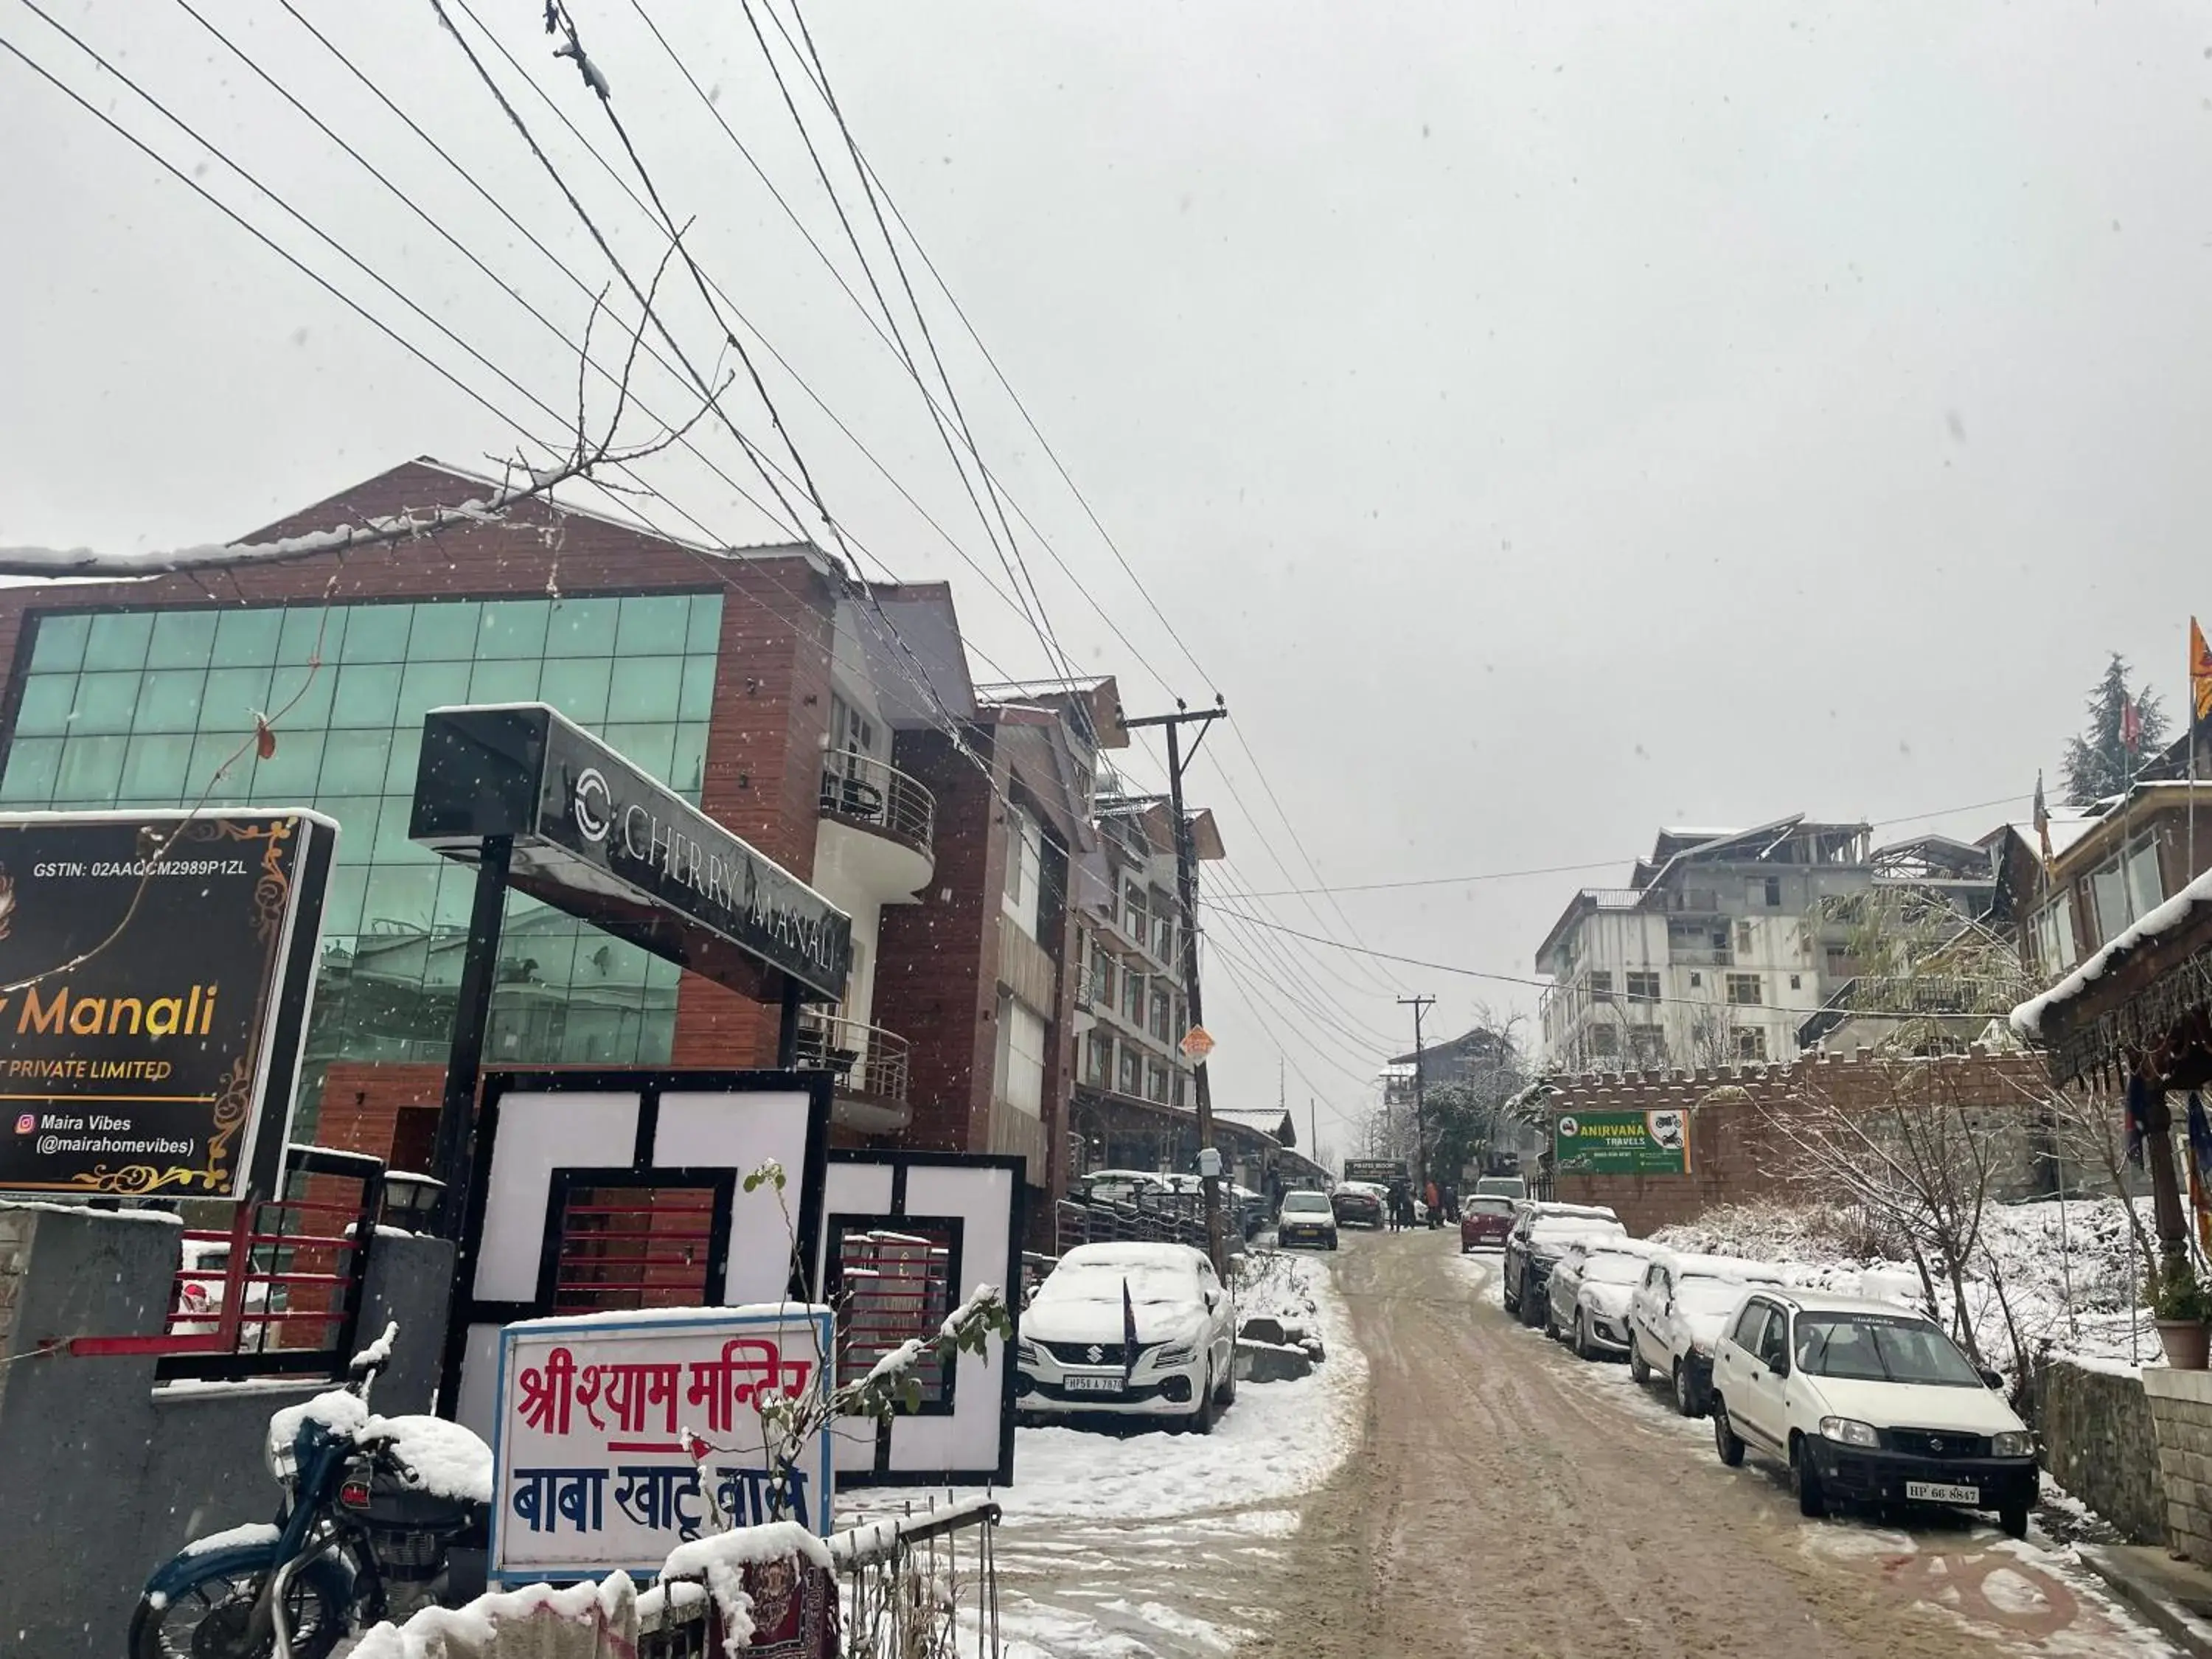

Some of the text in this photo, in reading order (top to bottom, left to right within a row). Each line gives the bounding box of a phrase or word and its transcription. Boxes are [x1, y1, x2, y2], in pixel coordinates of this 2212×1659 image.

[625, 804, 738, 911] CHERRY
[33, 863, 87, 877] GSTIN:
[16, 984, 218, 1034] Manali
[9, 1060, 87, 1079] PRIVATE
[90, 1061, 172, 1079] LIMITED
[41, 1114, 131, 1131] Maira Vibes
[1580, 1124, 1645, 1137] ANIRVANA
[36, 1135, 195, 1157] (@mairahomevibes)
[1606, 1137, 1646, 1146] TRAVELS
[512, 1467, 610, 1534] बाबा
[1910, 1486, 1927, 1498] HP
